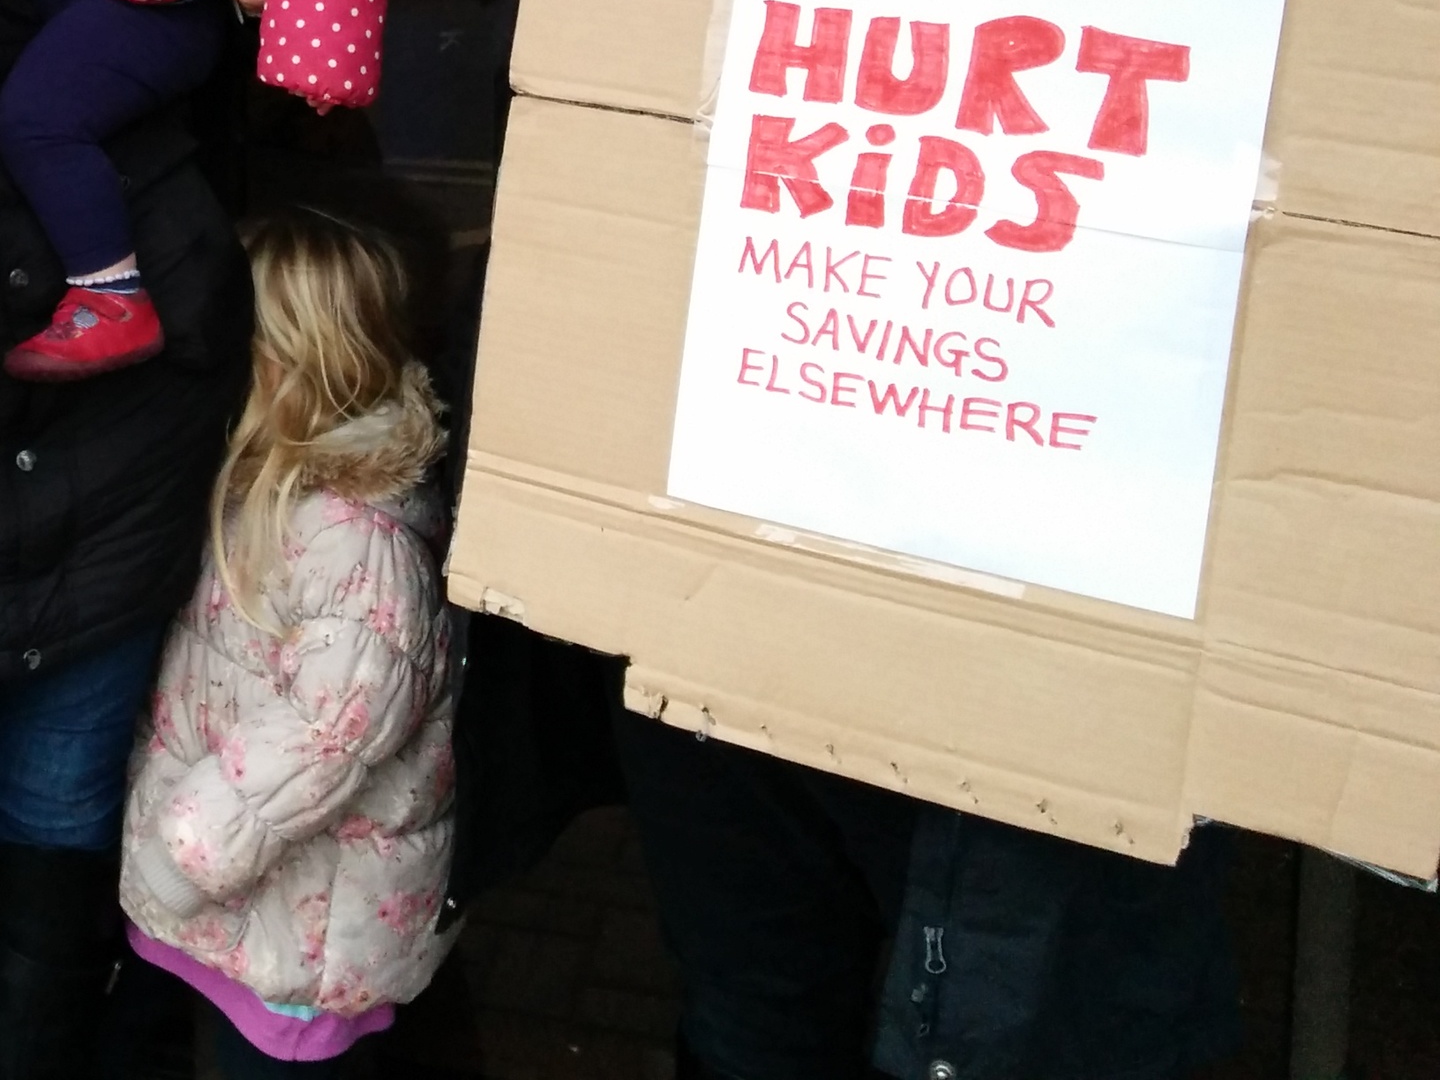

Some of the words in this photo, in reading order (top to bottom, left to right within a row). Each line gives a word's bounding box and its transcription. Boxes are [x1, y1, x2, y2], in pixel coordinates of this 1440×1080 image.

[748, 0, 1190, 155] HURT
[738, 237, 892, 297] MAKE
[916, 260, 1056, 327] YOUR
[781, 302, 1008, 382] SAVINGS
[737, 348, 1097, 450] ELSEWHERE
